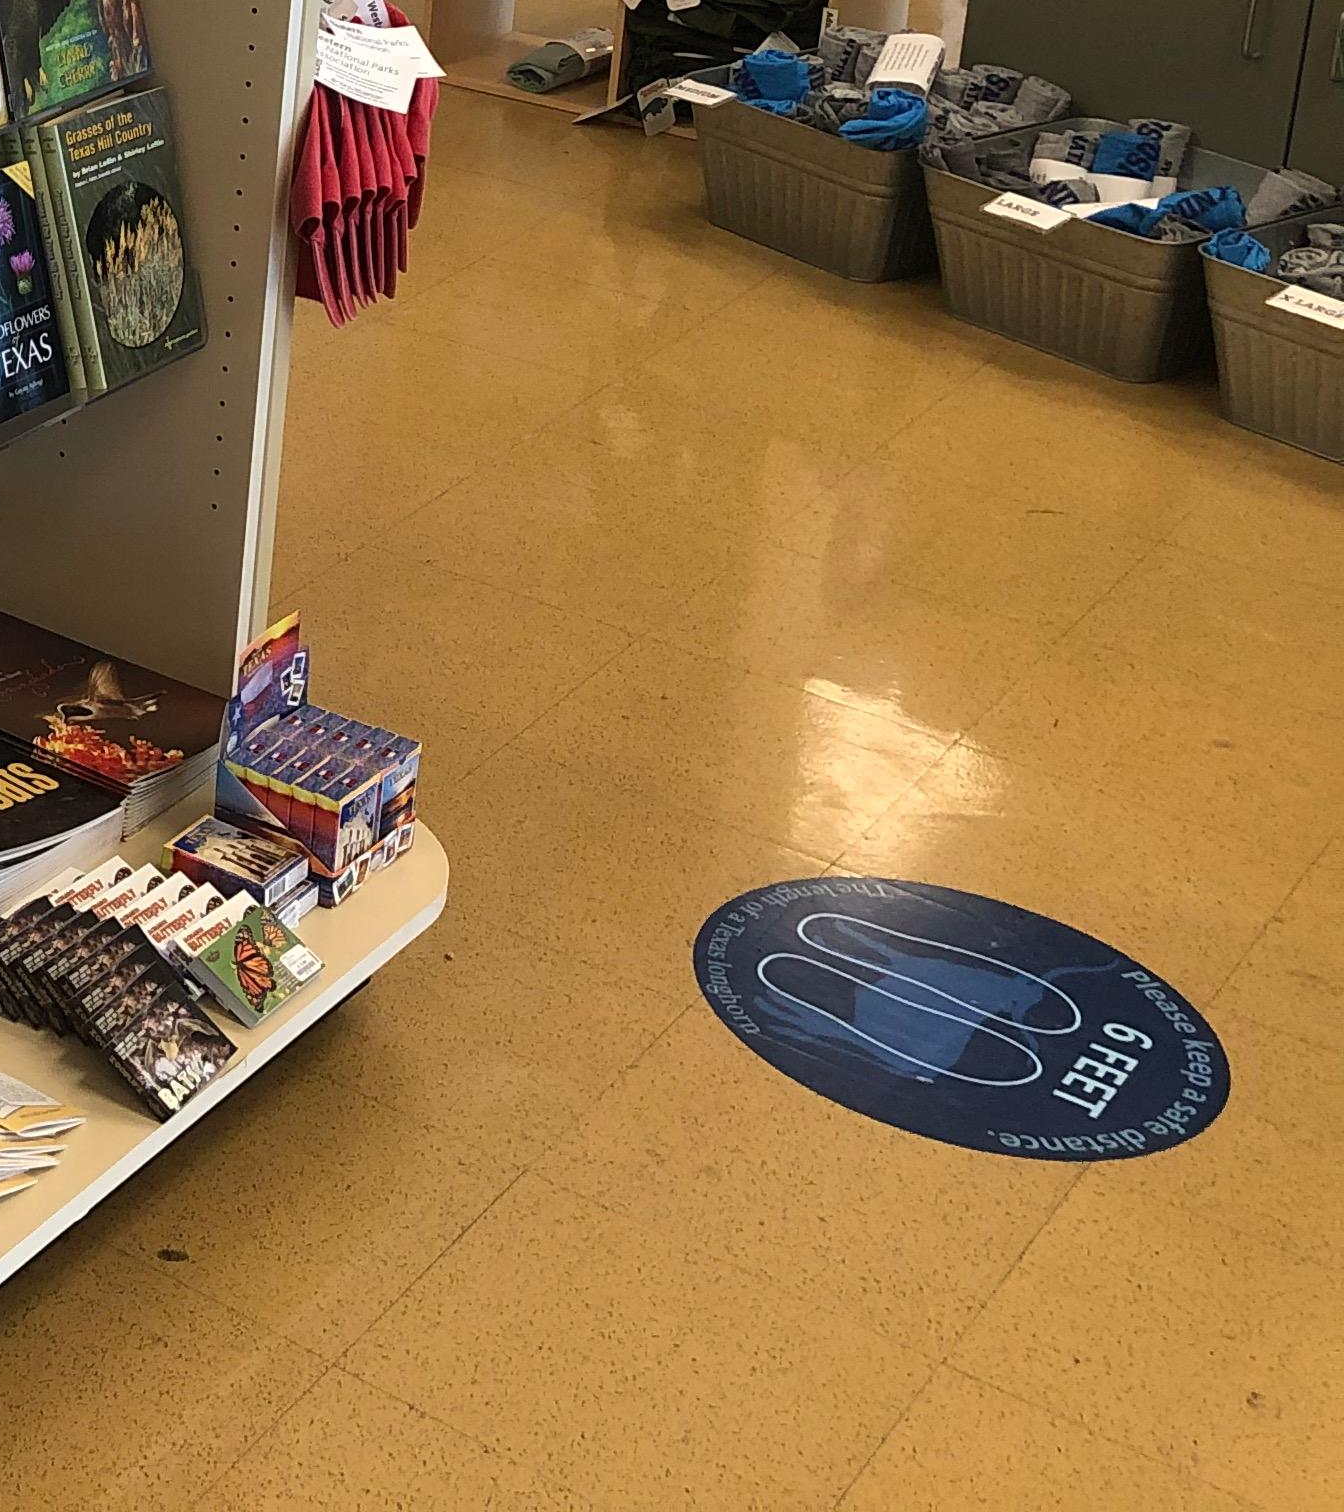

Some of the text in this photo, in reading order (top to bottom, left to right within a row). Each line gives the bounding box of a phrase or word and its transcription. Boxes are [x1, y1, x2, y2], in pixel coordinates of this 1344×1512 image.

[65, 112, 133, 146] Grasses of the
[69, 122, 152, 161] Texas Hill Country
[996, 198, 1041, 218] LARGE
[762, 885, 838, 907] length
[838, 883, 893, 898] The
[151, 909, 196, 943] BUTTERFLY
[742, 902, 763, 919] of
[186, 917, 233, 952] BUTTERFLY
[708, 923, 745, 959] Texas
[707, 960, 760, 1034] longhorn
[986, 968, 1214, 1156] Please keep a safe distance.
[1051, 1021, 1154, 1119] 6 FEET
